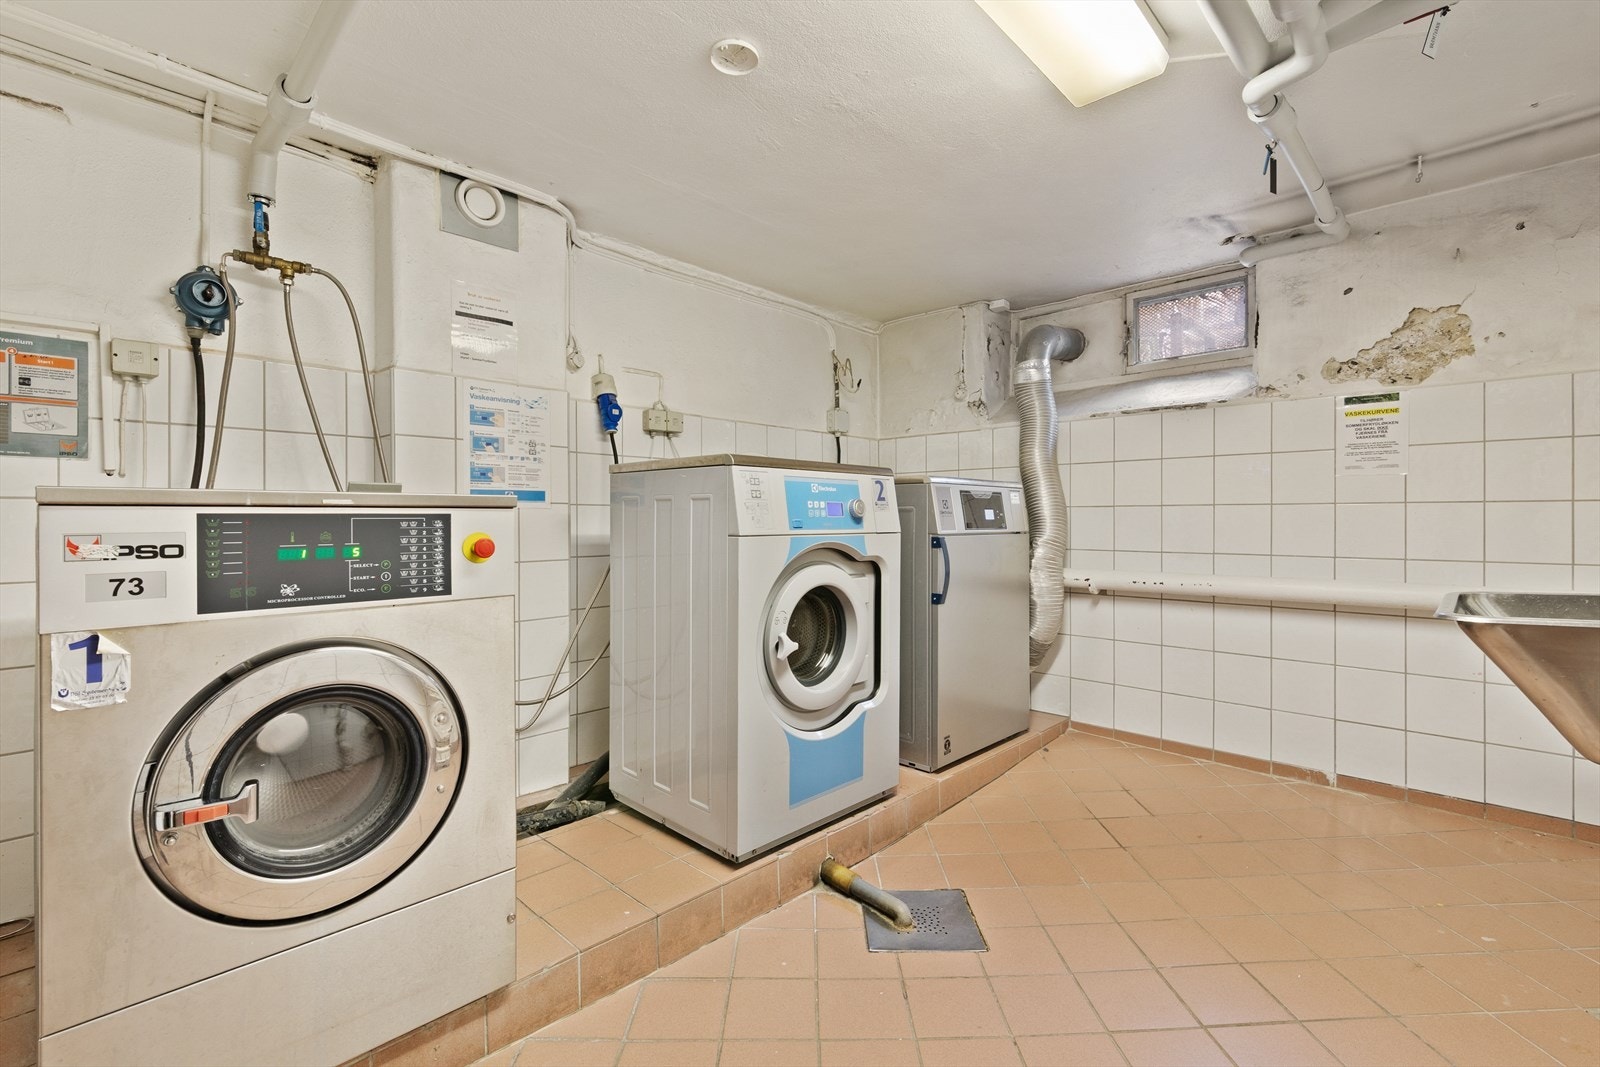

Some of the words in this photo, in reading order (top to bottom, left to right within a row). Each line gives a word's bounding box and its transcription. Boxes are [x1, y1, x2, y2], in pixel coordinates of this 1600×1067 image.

[0, 337, 33, 346] remium
[469, 392, 521, 406] Vaskeanvisning
[1345, 408, 1400, 417] VASKEKURVENE
[875, 480, 886, 501] 2
[103, 544, 185, 561] PSO
[108, 577, 145, 597] 73
[267, 596, 313, 604] MICROPROCESSOR
[68, 634, 103, 684] 1
